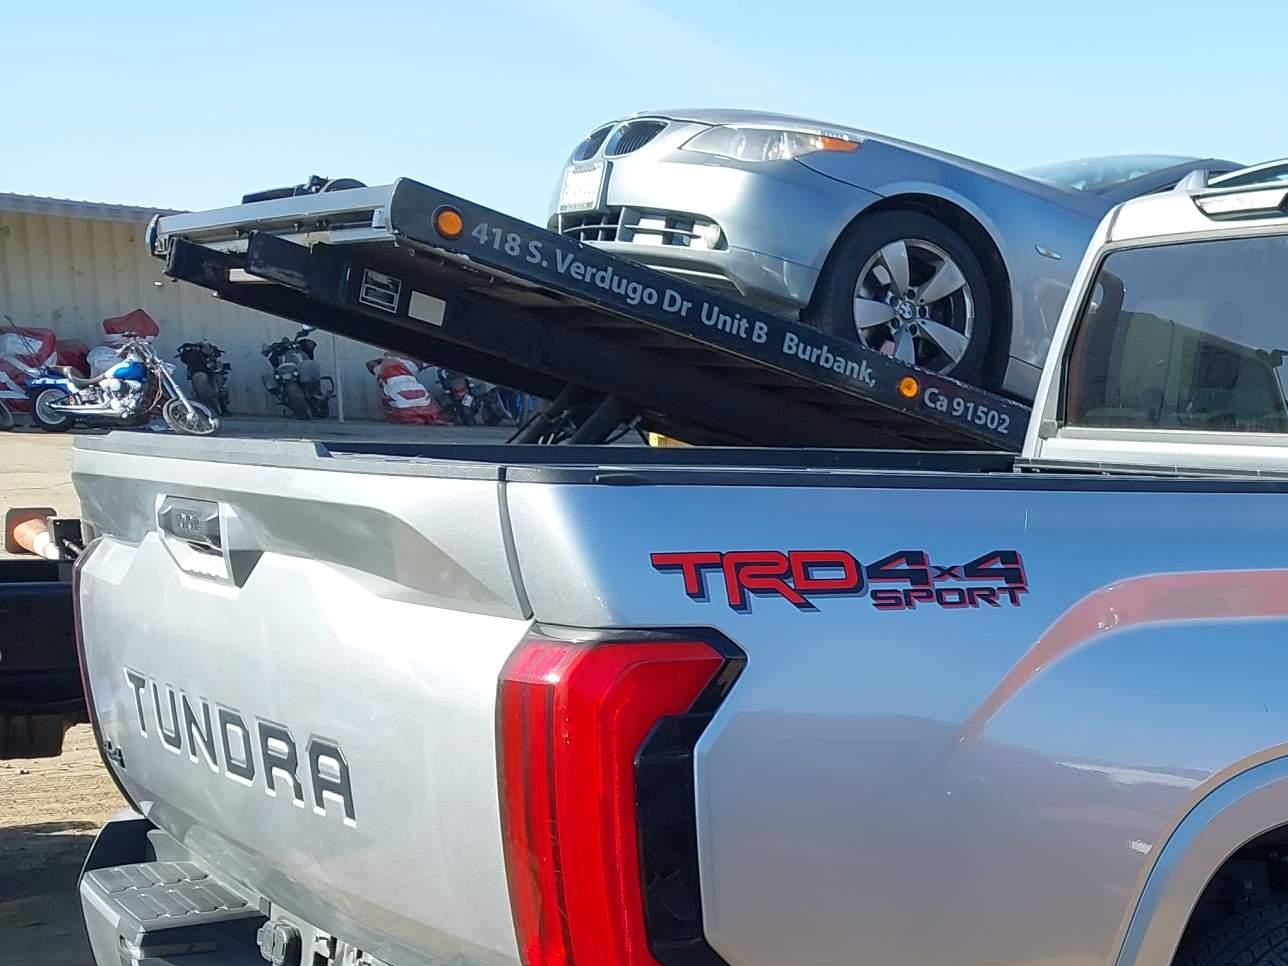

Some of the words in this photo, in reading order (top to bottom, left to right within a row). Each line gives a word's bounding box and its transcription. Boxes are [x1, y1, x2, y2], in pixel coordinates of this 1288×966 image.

[471, 223, 521, 256] 418
[526, 240, 548, 267] S.
[554, 249, 658, 305] Verdugo
[661, 288, 692, 317] Dr
[700, 302, 750, 339] Unit
[752, 321, 768, 345] B
[782, 332, 877, 388] Burbank,
[924, 388, 948, 412] Ca
[951, 397, 1010, 434] 91502
[650, 550, 866, 615] TRD
[871, 586, 1028, 611] SPORT
[123, 666, 357, 829] TUNDRA
